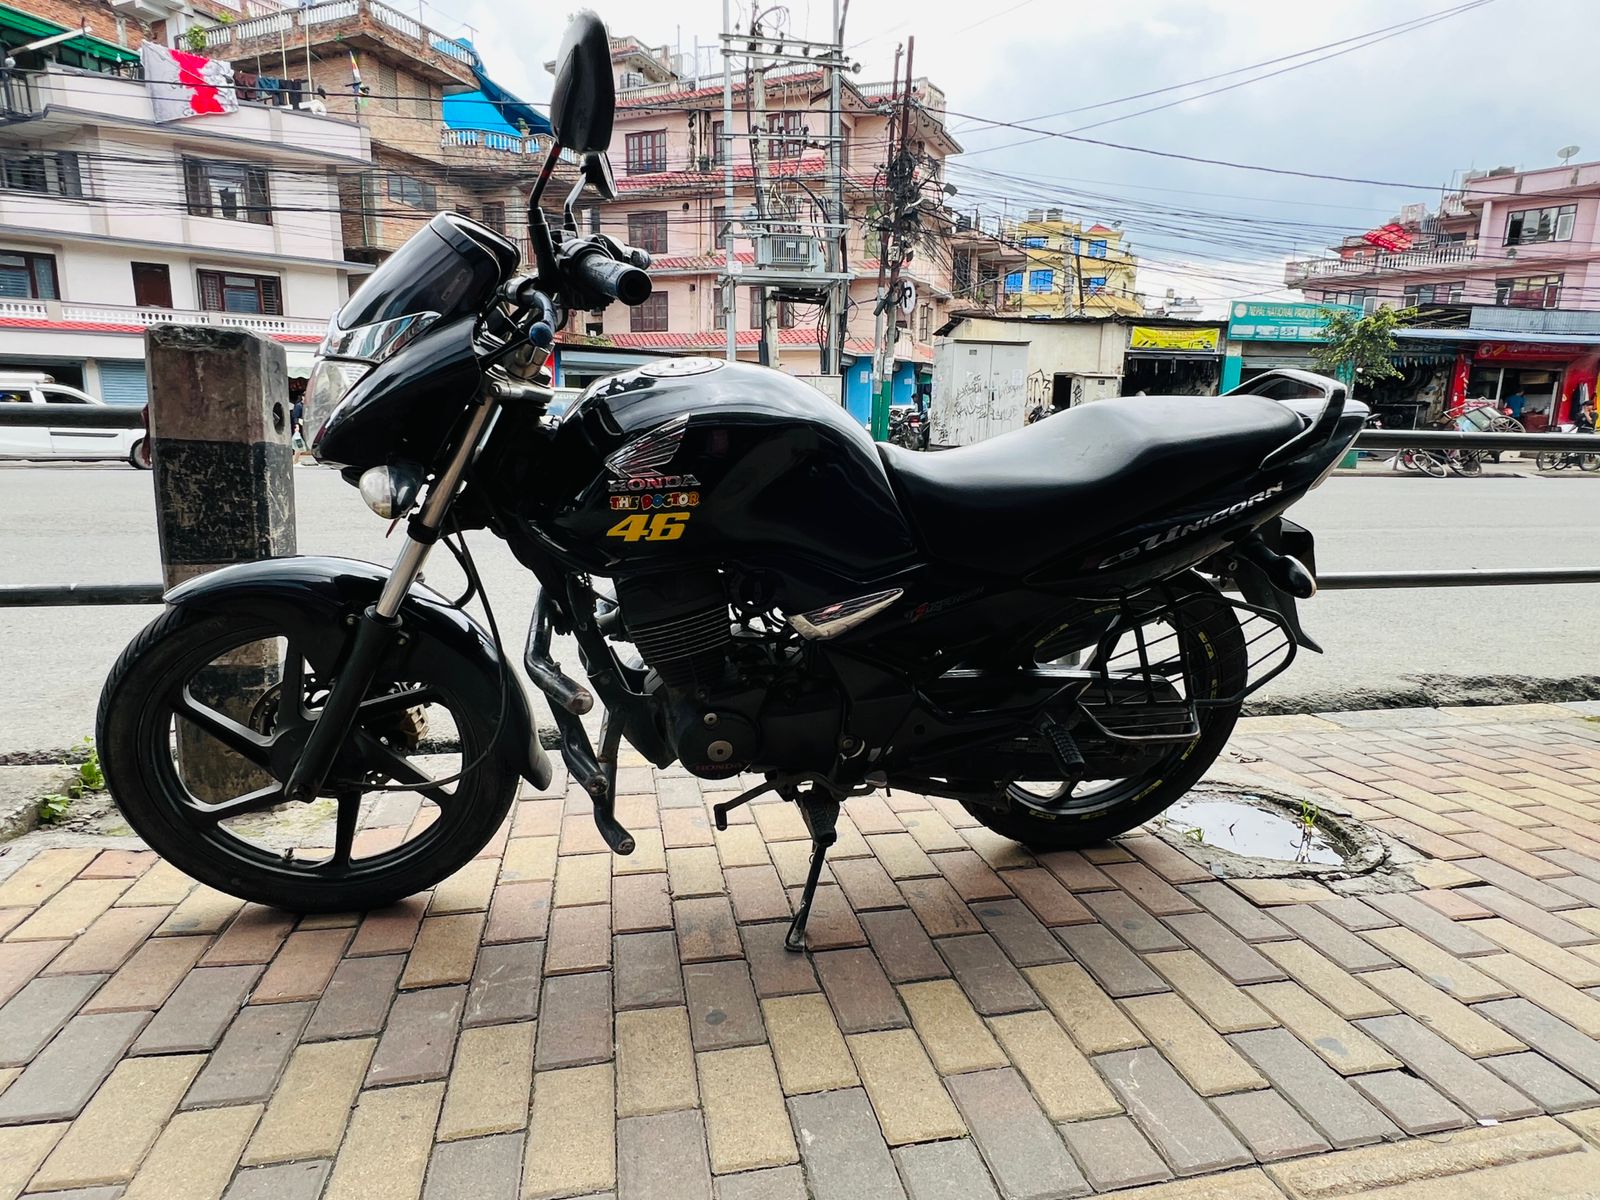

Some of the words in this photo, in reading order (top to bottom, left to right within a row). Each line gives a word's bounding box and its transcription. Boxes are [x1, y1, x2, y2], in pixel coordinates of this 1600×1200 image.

[607, 474, 701, 492] HONDA
[609, 495, 640, 511] THE
[640, 491, 700, 511] DOCTOR
[606, 512, 691, 542] 46
[1138, 480, 1284, 551] UNICORN
